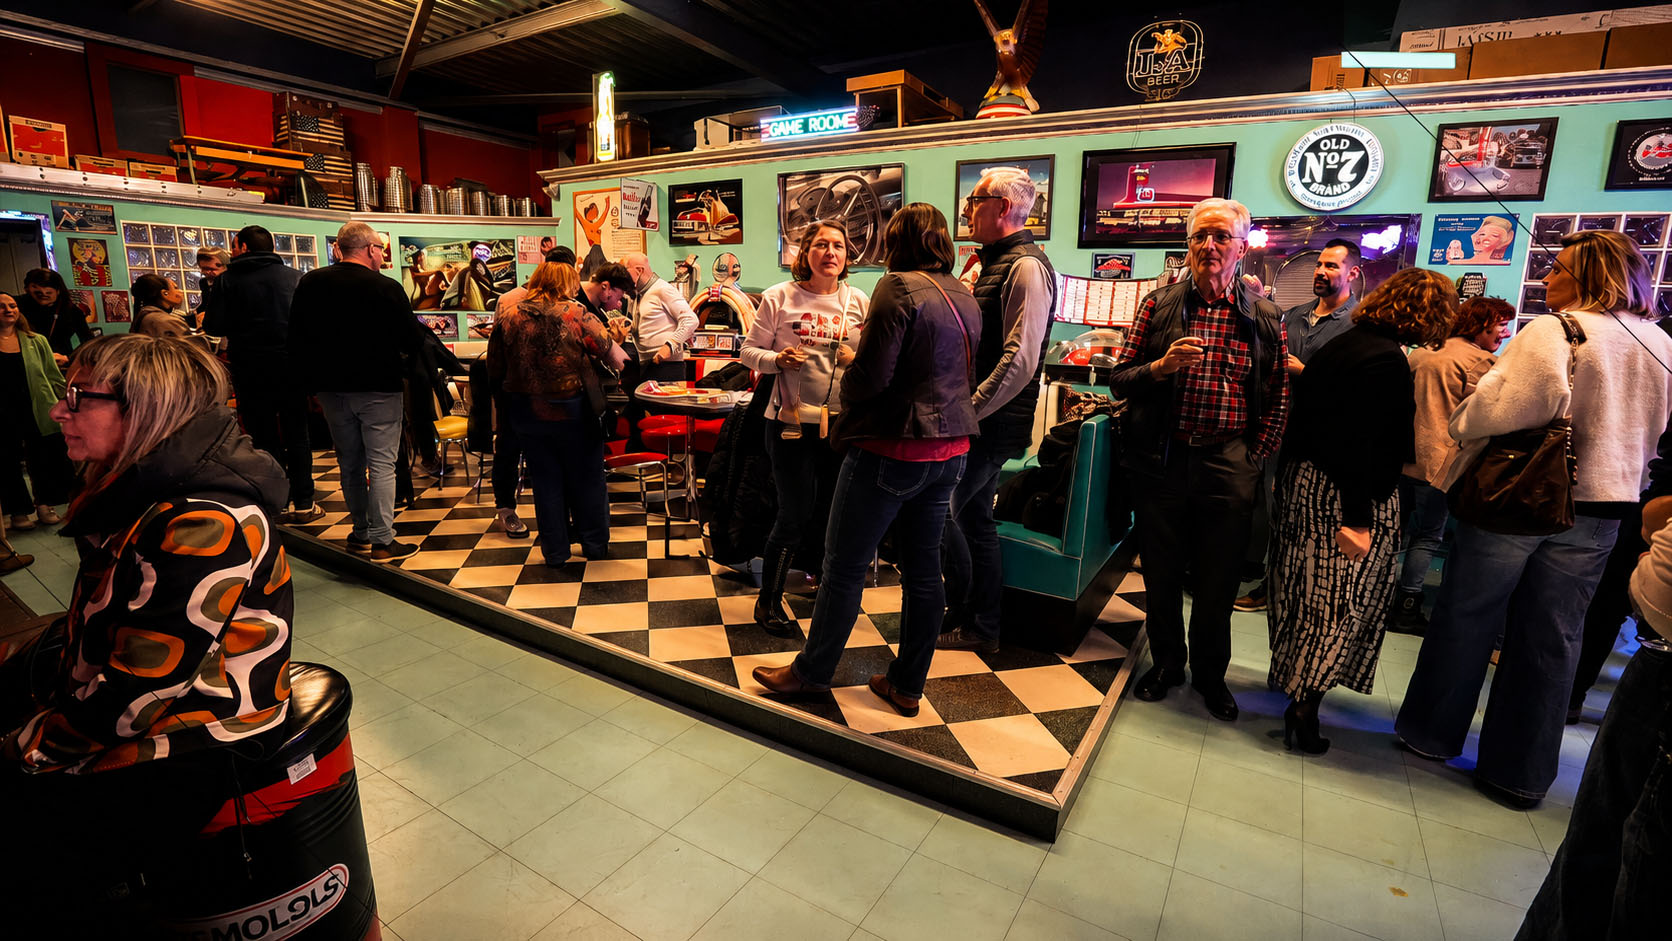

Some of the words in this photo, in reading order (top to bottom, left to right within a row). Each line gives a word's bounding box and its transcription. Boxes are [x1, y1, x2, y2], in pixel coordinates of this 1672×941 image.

[1147, 74, 1180, 86] BEER
[769, 119, 804, 137] GAME
[1319, 138, 1350, 150] OLD
[1308, 182, 1351, 196] BRAND
